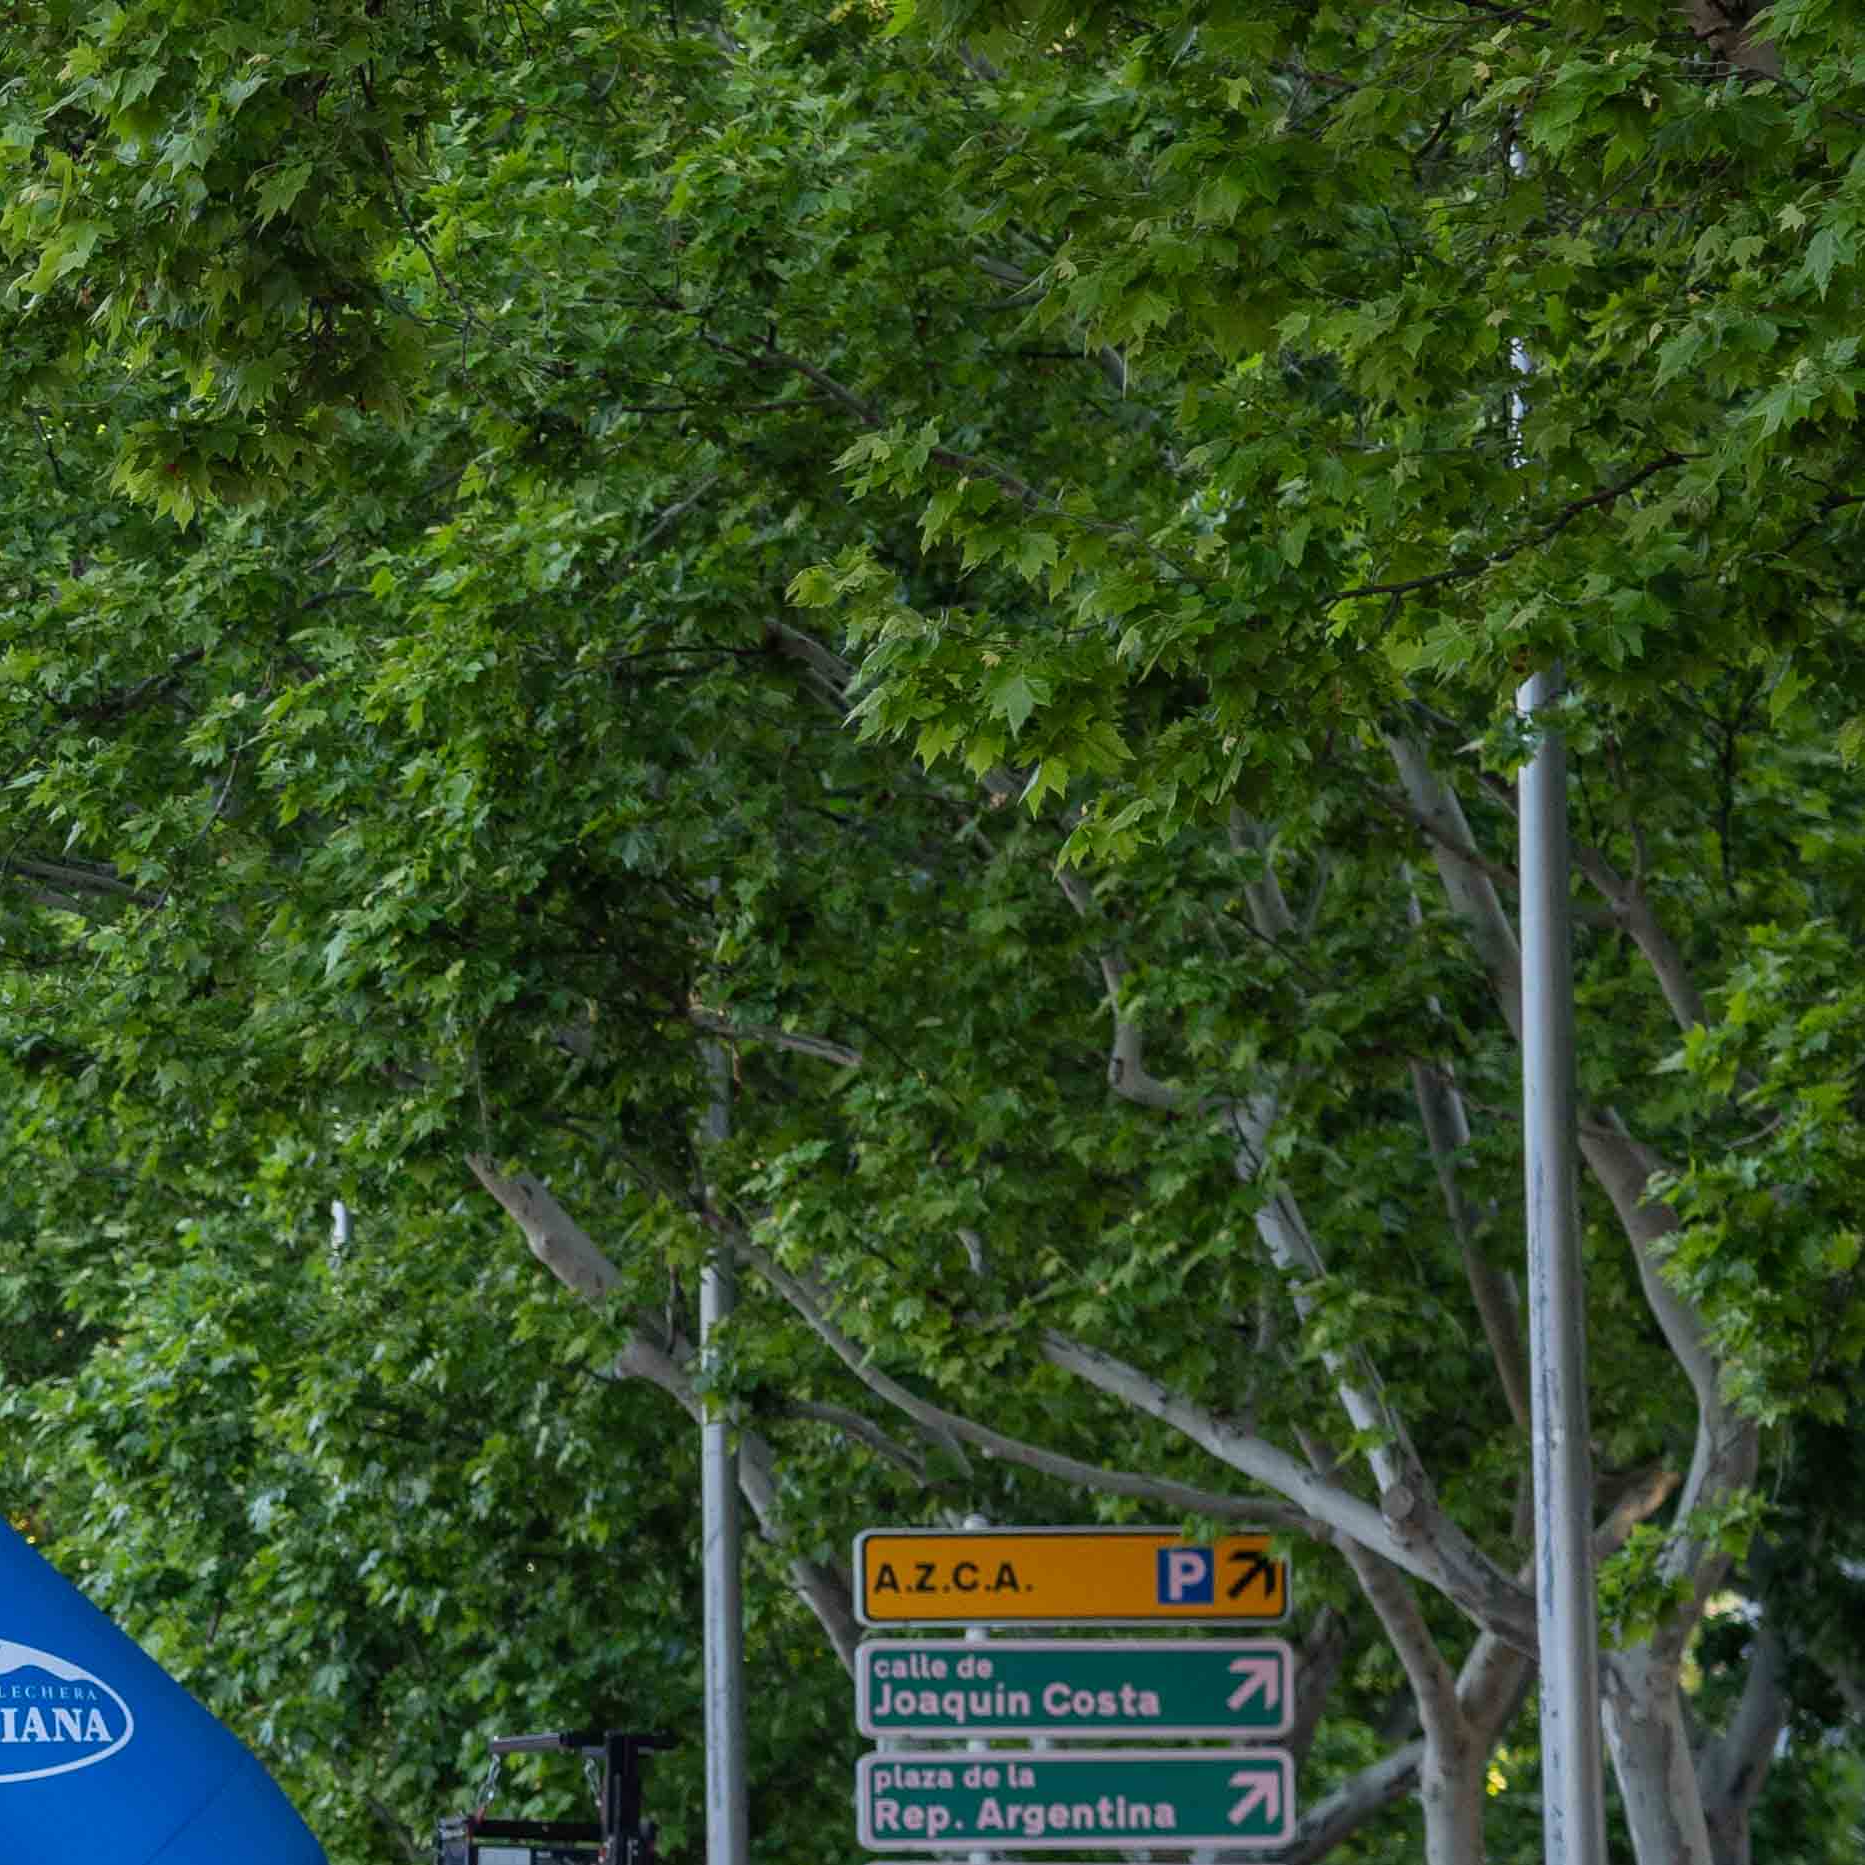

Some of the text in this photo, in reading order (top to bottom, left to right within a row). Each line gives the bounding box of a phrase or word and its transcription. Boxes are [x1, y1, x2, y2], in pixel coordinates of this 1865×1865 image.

[873, 1553, 1205, 1599] A.Z.C.A. P
[874, 1654, 992, 1679] calle de
[1043, 1684, 1160, 1716] Costa
[874, 1764, 1035, 1793] plaza de la
[874, 1798, 1175, 1838] Rep. Argentina
